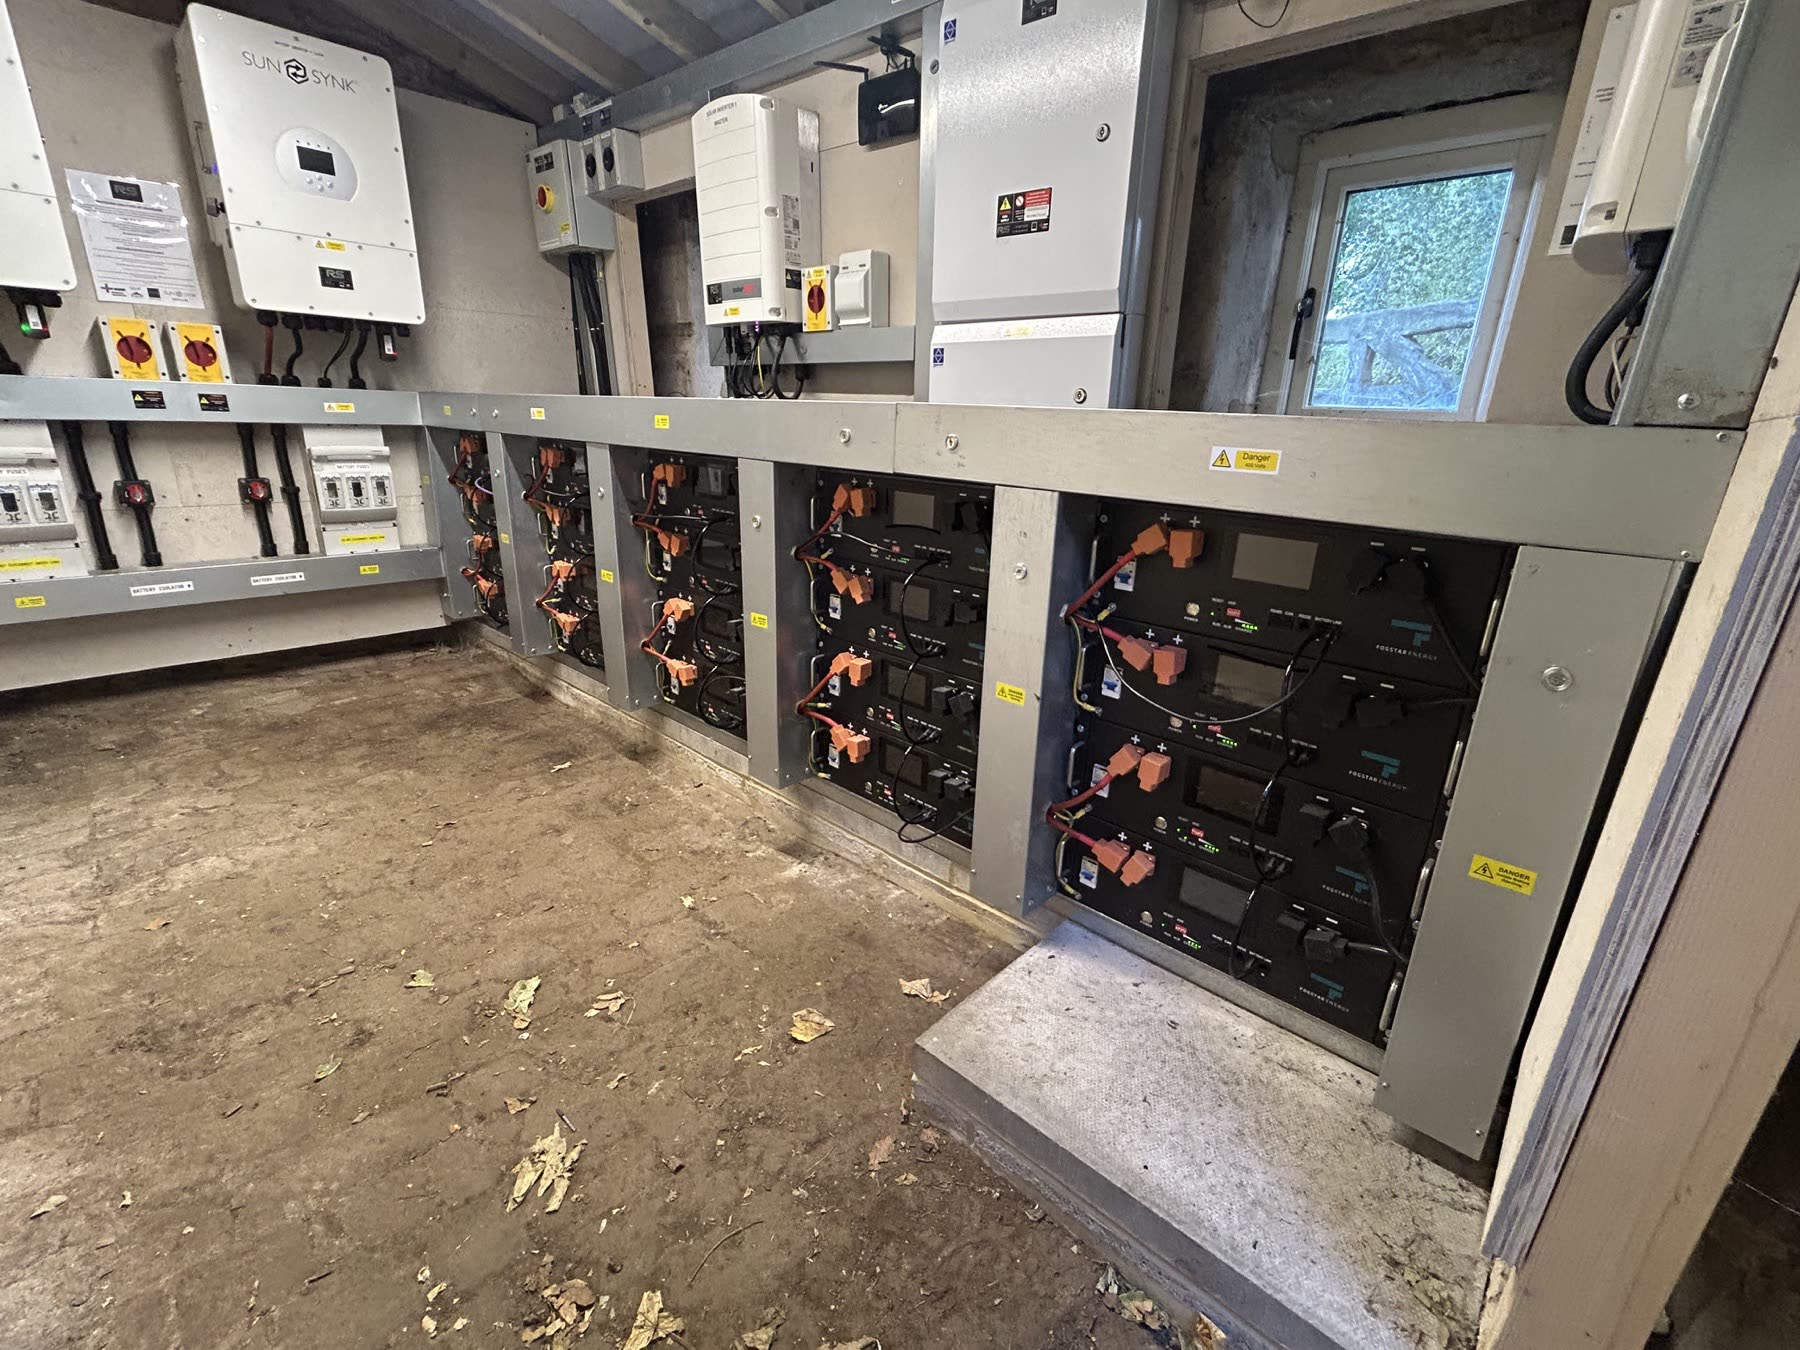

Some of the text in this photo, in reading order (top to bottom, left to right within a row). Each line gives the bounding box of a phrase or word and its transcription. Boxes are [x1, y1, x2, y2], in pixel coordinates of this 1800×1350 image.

[242, 51, 356, 94] SUN SYNK
[326, 269, 345, 279] RS
[1242, 452, 1271, 463] Danger
[158, 584, 184, 592] ISOLATOR
[1376, 644, 1438, 661] FOGSTAR ENERGY
[1348, 770, 1378, 782] FOGSTAR
[1498, 867, 1530, 880] DANGER
[1322, 884, 1350, 898] FOGSTAR
[1299, 986, 1325, 1002] FOGSTAR
